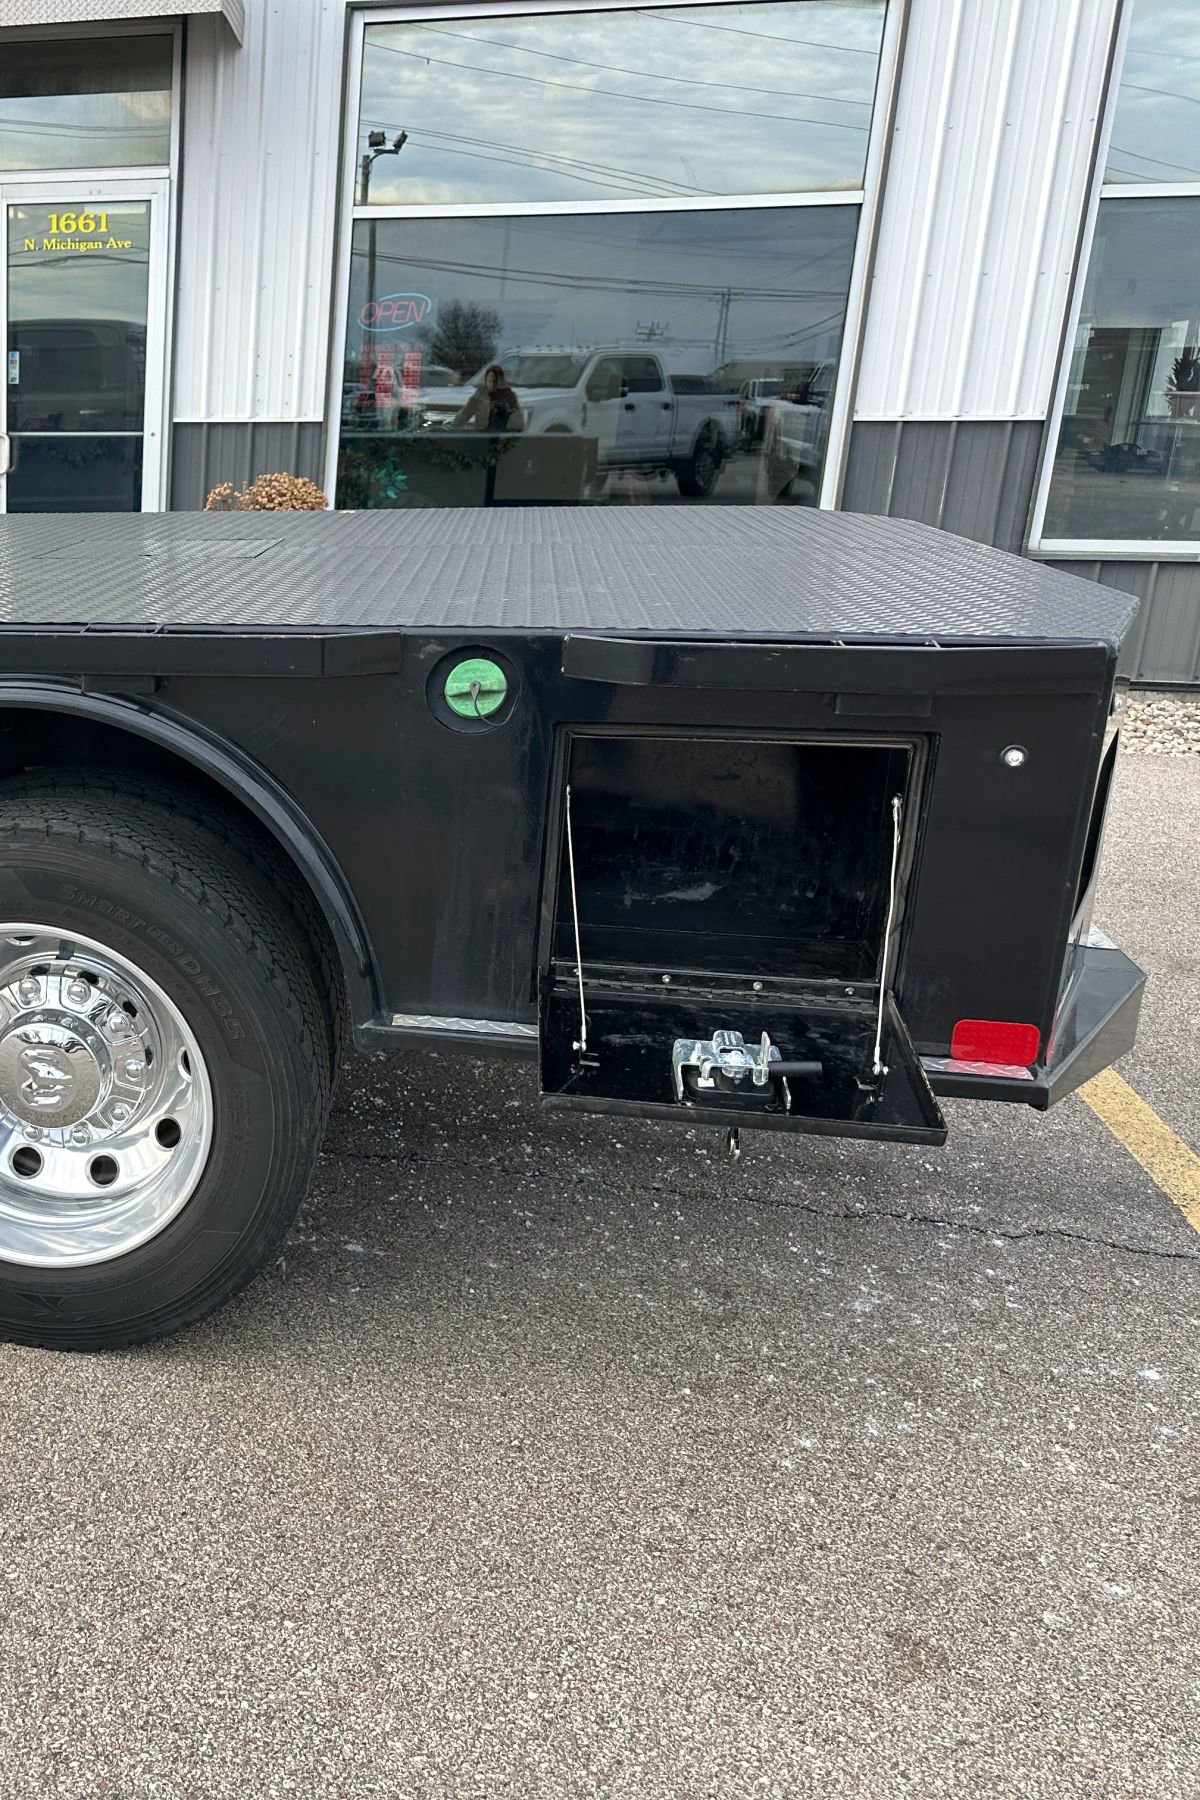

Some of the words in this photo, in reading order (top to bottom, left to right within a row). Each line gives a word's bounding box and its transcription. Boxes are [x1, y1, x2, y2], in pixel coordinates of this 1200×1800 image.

[48, 212, 108, 234] 1661
[24, 239, 39, 251] N.
[43, 238, 103, 252] Michigan
[106, 237, 132, 249] Ave
[361, 301, 425, 323] OPEN
